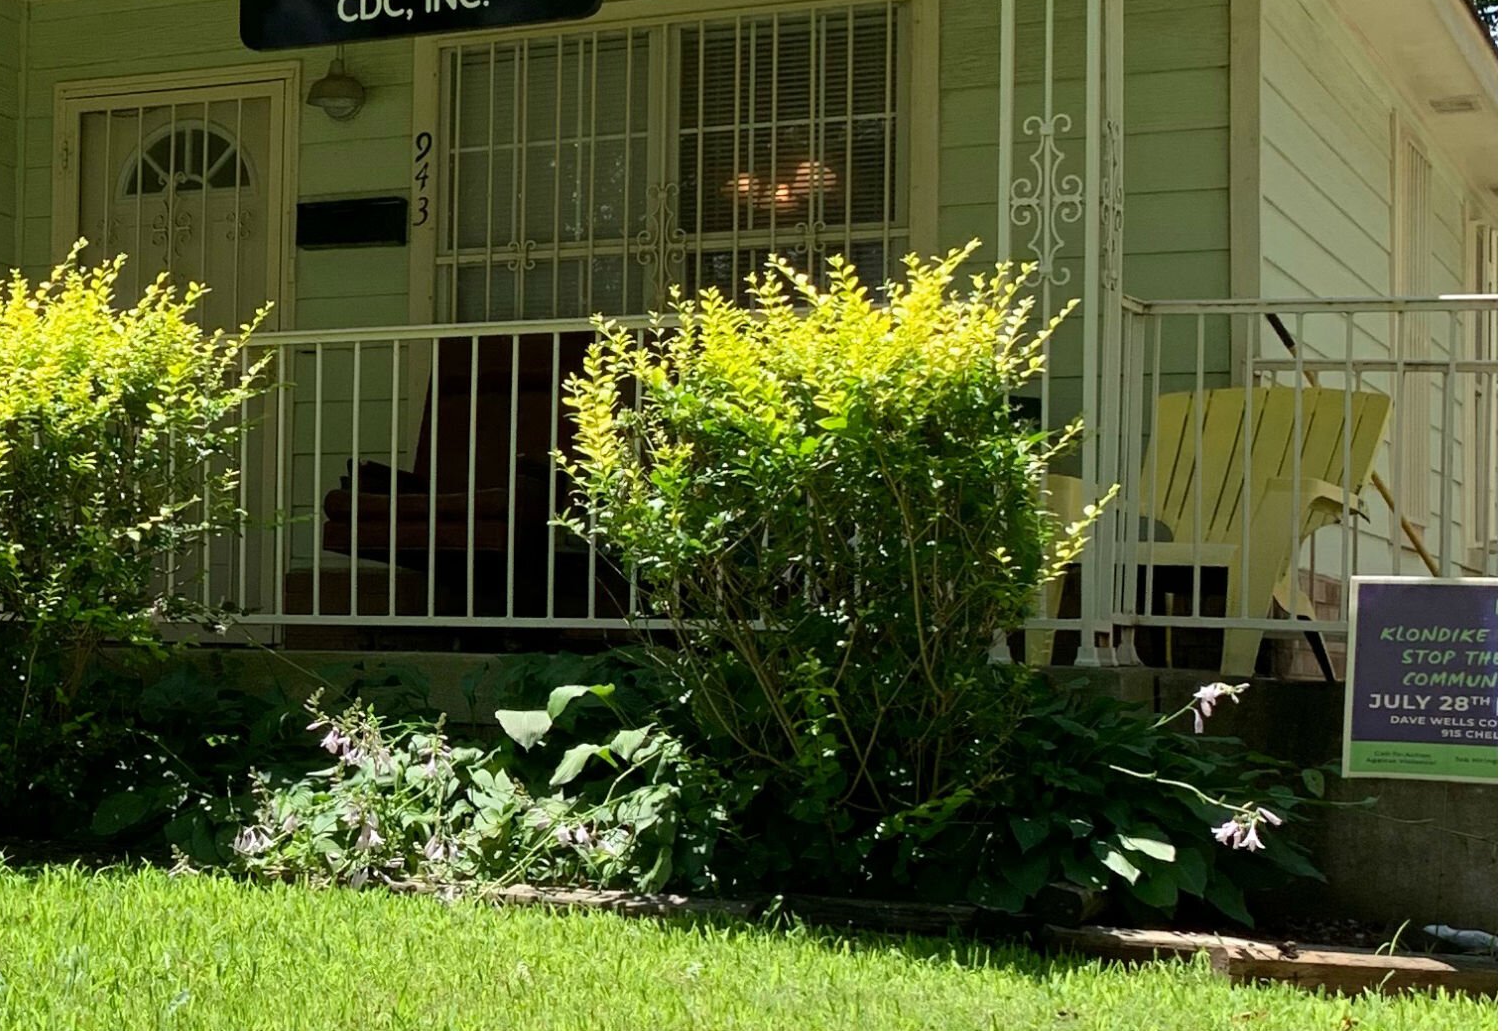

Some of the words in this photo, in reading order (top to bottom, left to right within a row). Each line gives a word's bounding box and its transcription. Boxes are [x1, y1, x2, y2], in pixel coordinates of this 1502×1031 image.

[413, 131, 433, 227] 943
[1380, 625, 1491, 643] KLONDIKE
[1401, 649, 1456, 665] STOP
[1368, 693, 1432, 710] JULY
[1390, 715, 1426, 725] DAVE
[1430, 717, 1475, 727] WELLS
[1441, 729, 1462, 738] 915
